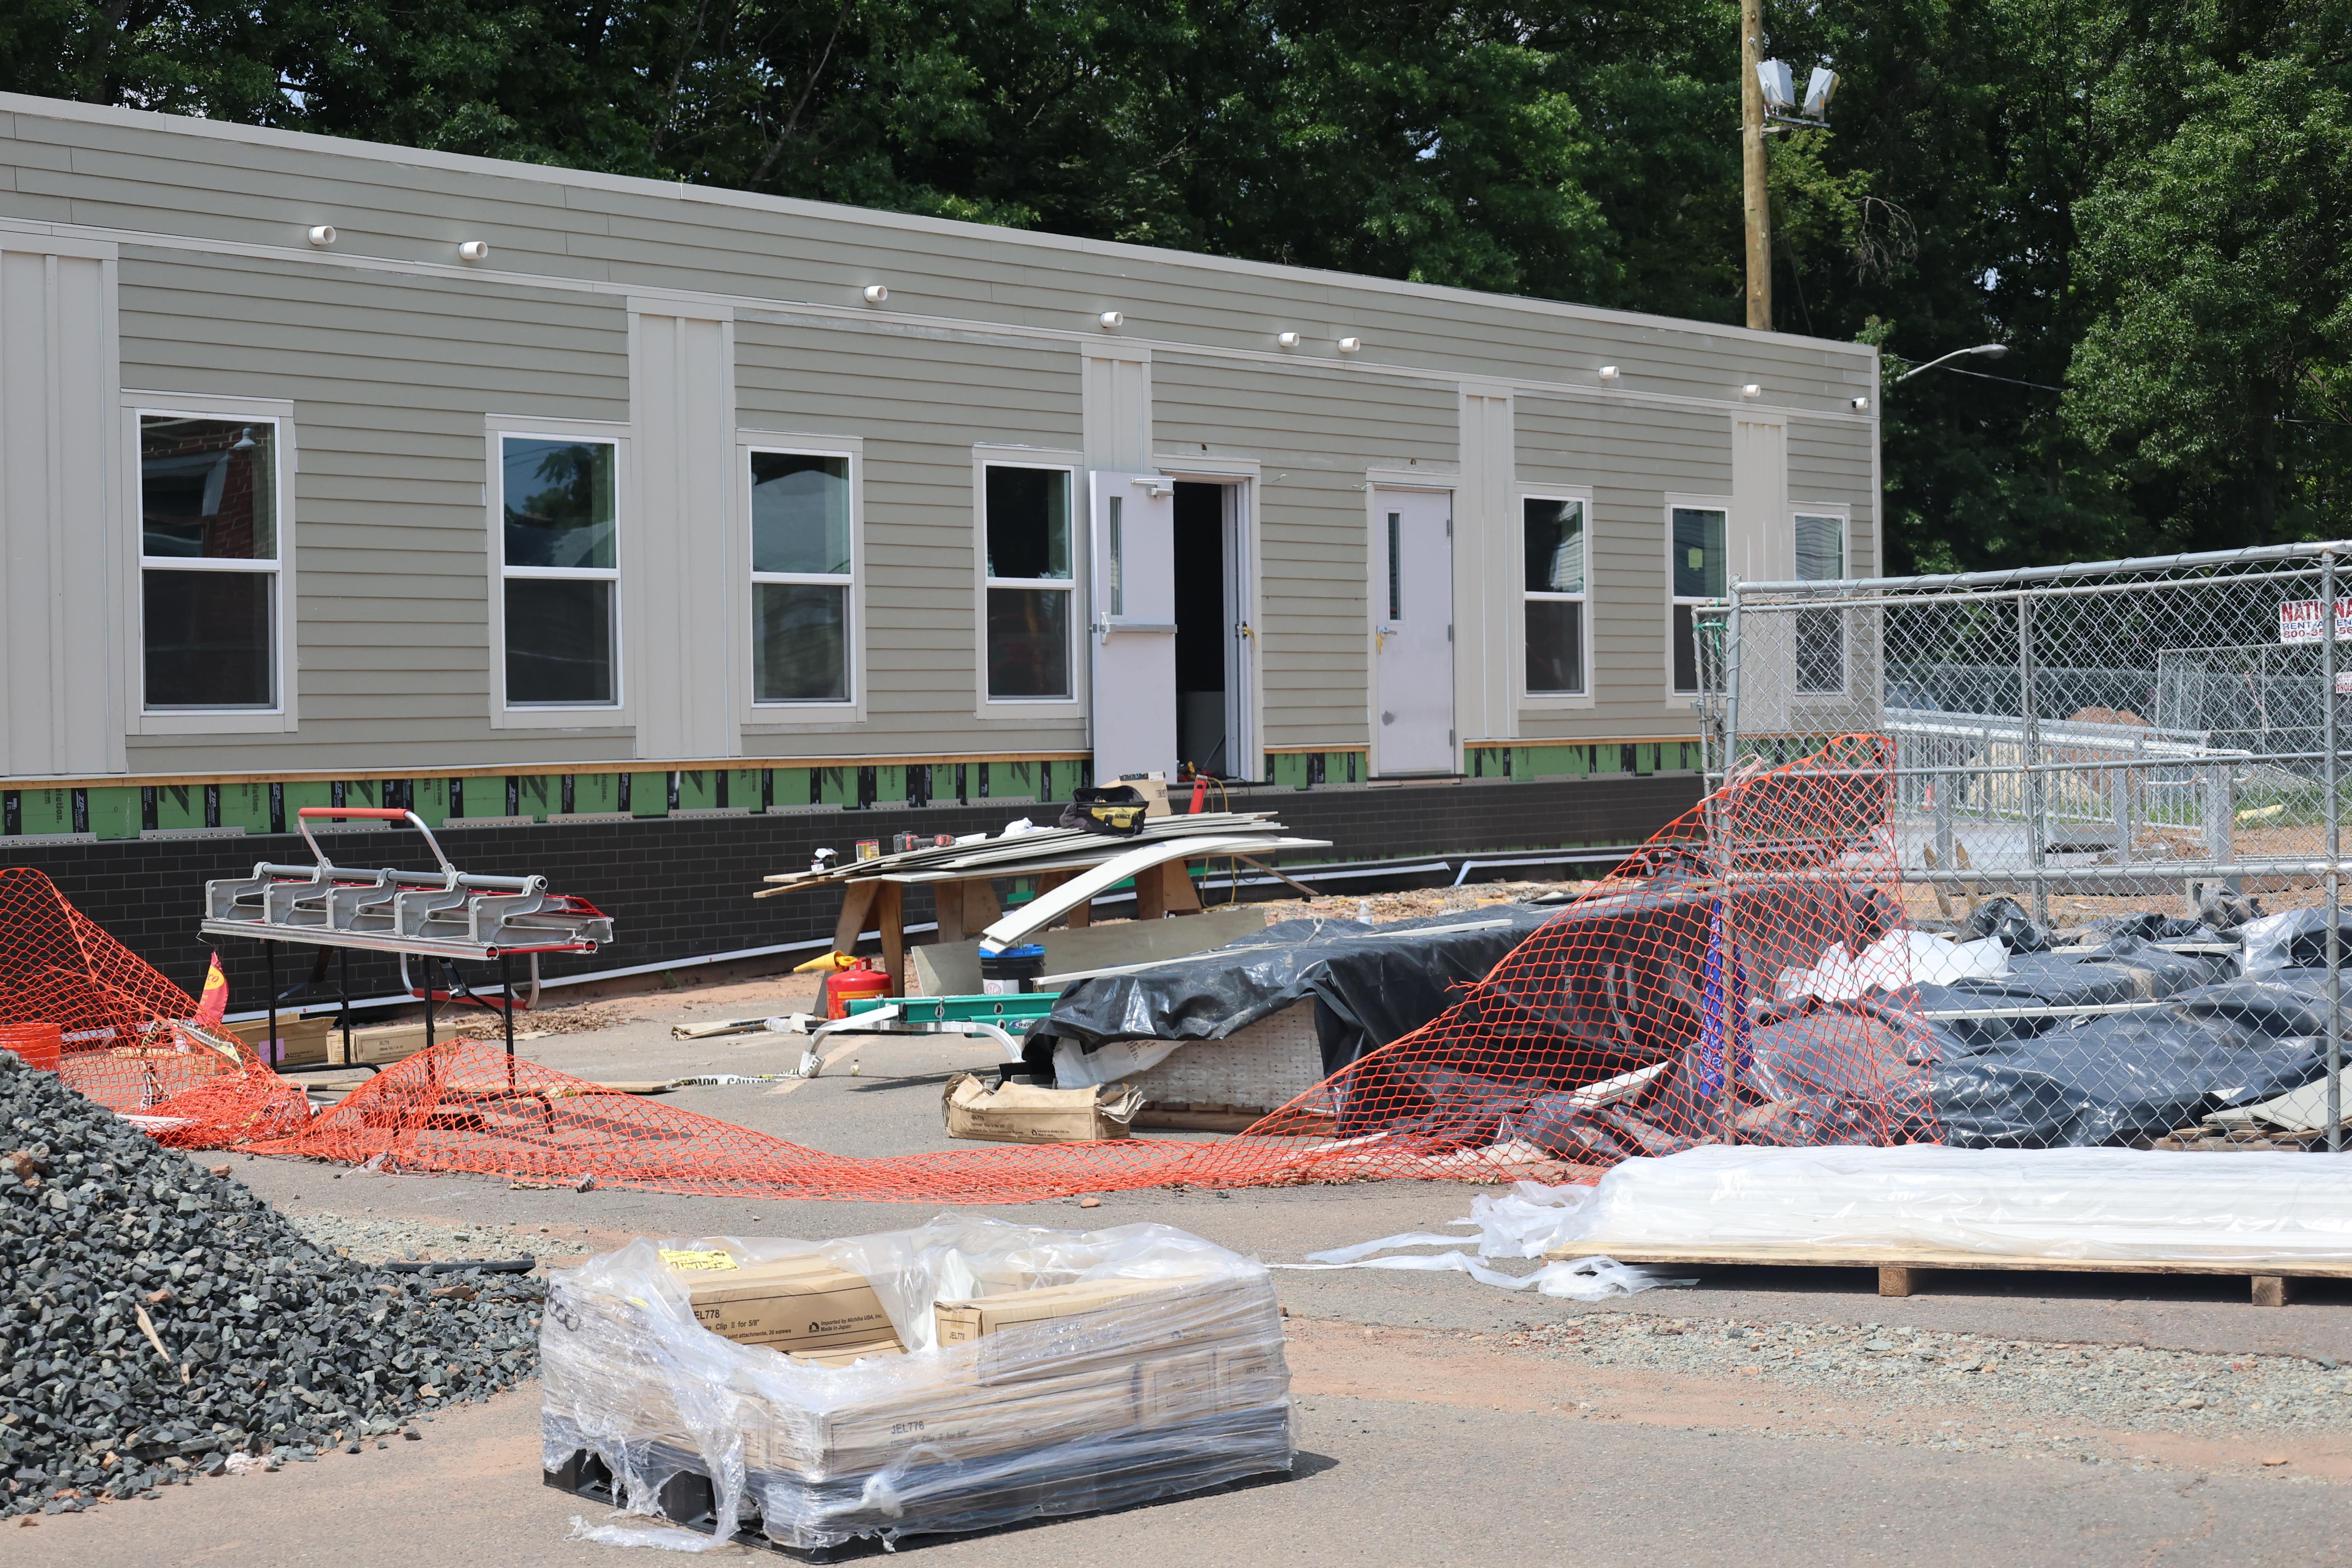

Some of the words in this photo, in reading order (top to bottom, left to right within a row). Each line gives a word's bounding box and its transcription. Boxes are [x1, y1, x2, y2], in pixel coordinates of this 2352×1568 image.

[2282, 598, 2352, 622] NATINA
[2283, 619, 2352, 630] RENT-AEN
[2283, 627, 2352, 638] 800-35-56
[987, 984, 999, 994] STP
[949, 1331, 965, 1340] JEL778
[891, 1421, 924, 1434] JEL778
